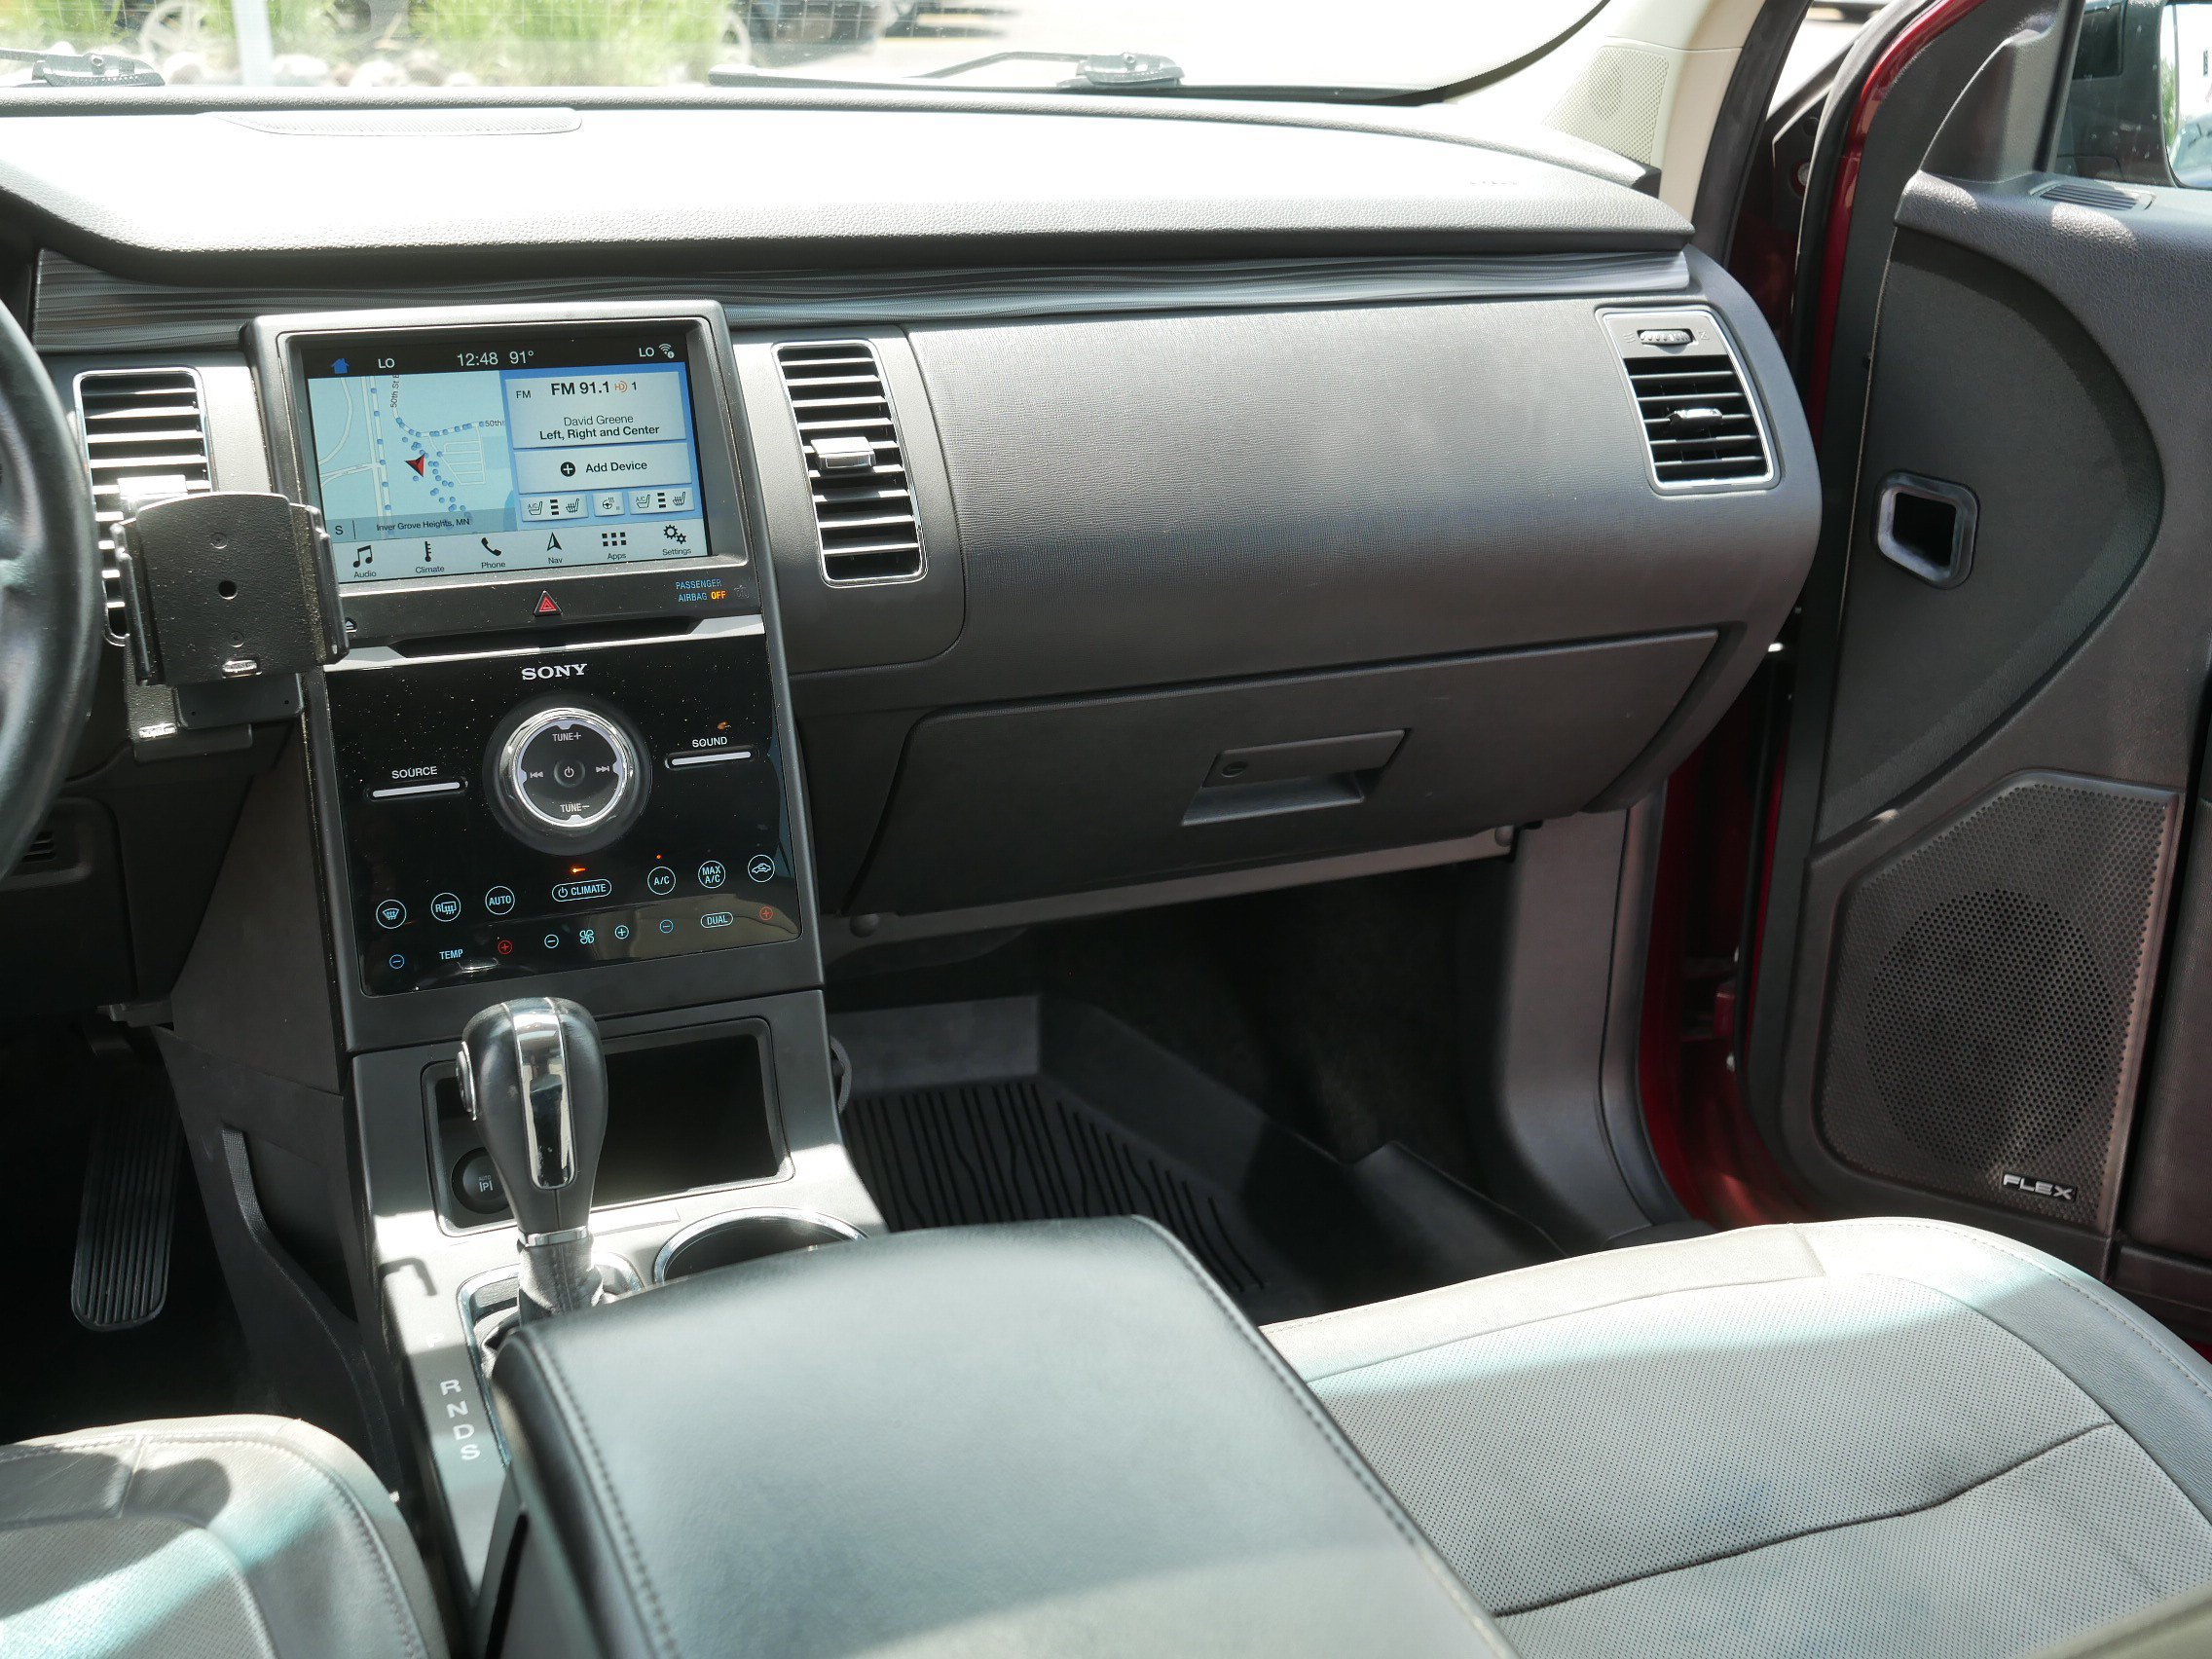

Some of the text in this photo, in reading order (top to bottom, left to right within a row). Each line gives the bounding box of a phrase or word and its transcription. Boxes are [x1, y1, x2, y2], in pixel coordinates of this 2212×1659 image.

[458, 350, 534, 366] 12:48 91°
[639, 347, 654, 357] LO
[378, 358, 394, 369] LO
[516, 390, 532, 399] FM
[551, 383, 575, 395] FM
[579, 382, 609, 394] 91.1
[564, 415, 633, 426] David Greene
[539, 425, 660, 440] Left, Right and Center
[585, 461, 647, 473] Add Device
[335, 526, 344, 535] S
[377, 523, 395, 532] Inver
[398, 521, 422, 531] Grove
[423, 519, 455, 529] Heights,
[608, 552, 627, 561] Apps
[662, 547, 691, 556] Settings
[416, 565, 445, 574] Climate
[481, 561, 505, 570] Phone
[676, 578, 721, 590] PASSENGER
[679, 590, 726, 602] AIRBAG OFF
[521, 663, 588, 681] SONY
[692, 737, 727, 748] SOUND
[391, 765, 437, 779] SOURCE
[702, 866, 721, 875] MAX
[653, 876, 670, 886] A/C
[705, 874, 720, 884] A/C
[571, 883, 607, 896] CLIMATE
[489, 895, 511, 905] AUTO
[707, 914, 728, 925] DUAL
[439, 948, 463, 960] TEMP
[2003, 1173, 2073, 1199] FLEX
[440, 1379, 462, 1395] R
[446, 1401, 469, 1418] N
[453, 1423, 475, 1441] D
[461, 1444, 481, 1460] S
